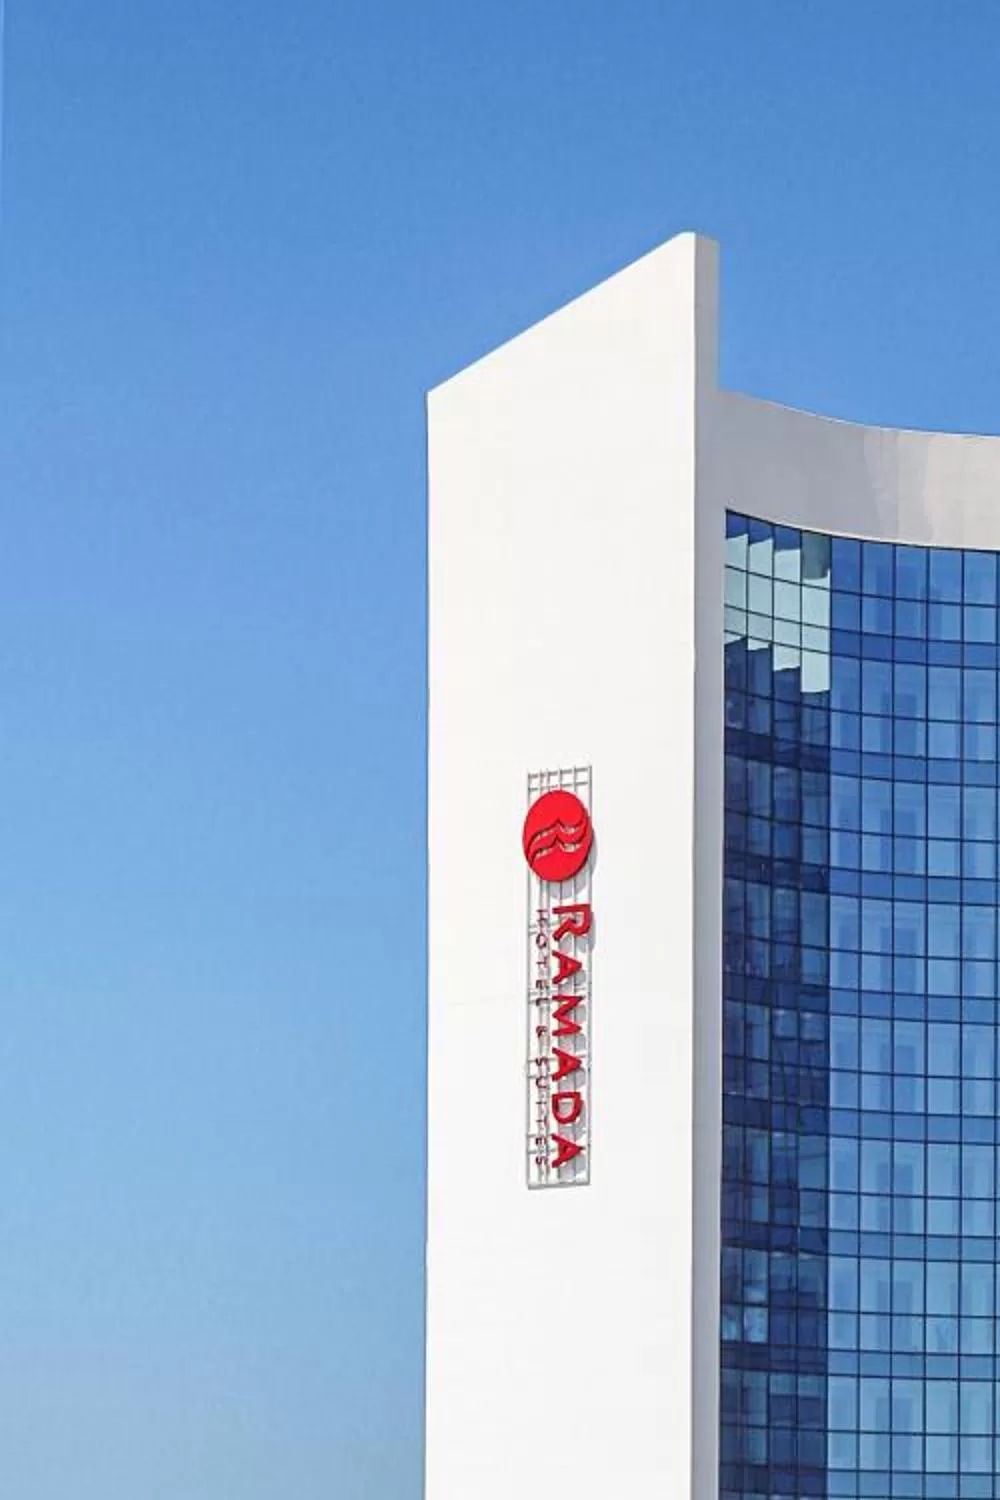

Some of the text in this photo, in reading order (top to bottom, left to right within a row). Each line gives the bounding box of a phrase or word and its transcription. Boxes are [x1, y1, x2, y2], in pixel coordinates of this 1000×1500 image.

[536, 908, 549, 1007] HOTEL
[552, 903, 591, 1168] RAMADA
[535, 1055, 548, 1166] SUITES
